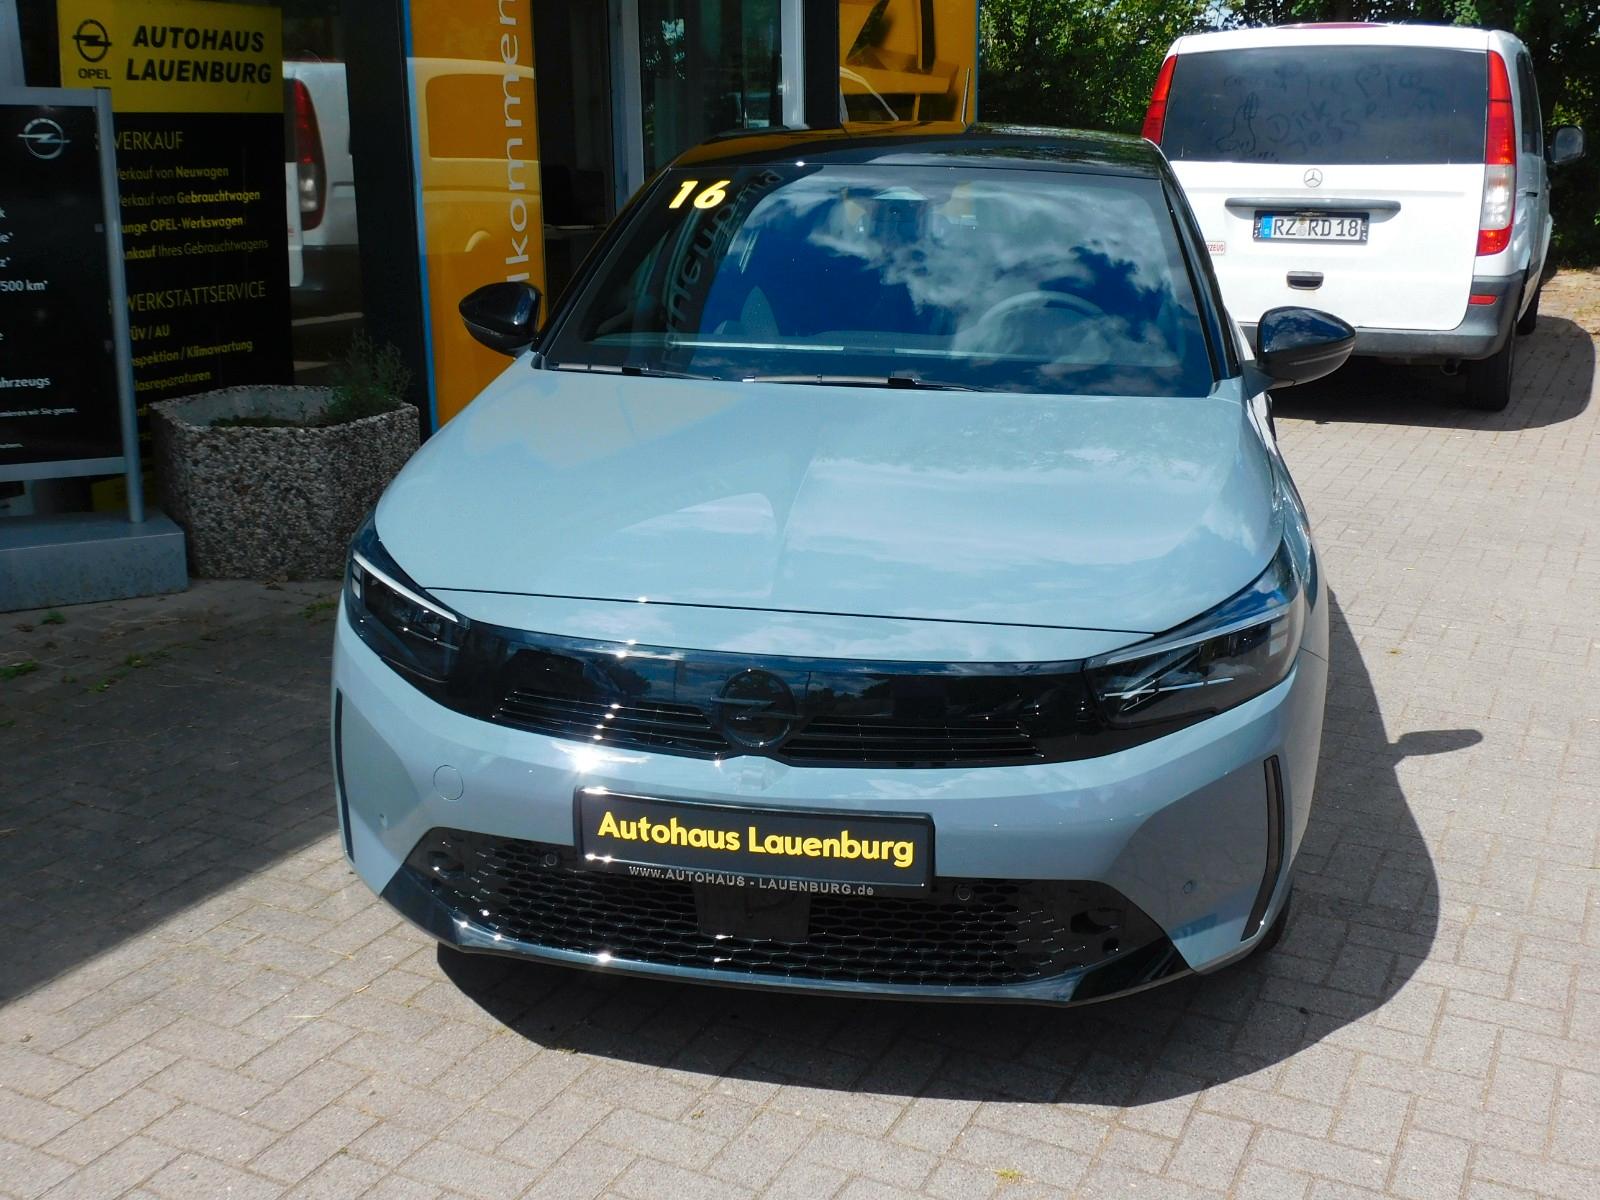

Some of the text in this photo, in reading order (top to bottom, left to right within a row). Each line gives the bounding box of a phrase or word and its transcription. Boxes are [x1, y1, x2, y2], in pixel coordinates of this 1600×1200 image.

[133, 25, 264, 52] AUTOHAUS
[78, 68, 111, 79] OPEL
[126, 59, 272, 84] LAUENBURG
[498, 0, 531, 283] lkommen
[117, 166, 155, 181] erkauf
[175, 165, 229, 180] Neuwagen
[119, 192, 156, 207] erkauf
[177, 189, 260, 205] Gebrauchtwagen
[668, 180, 730, 209] 16
[121, 215, 243, 237] unge OPEL-Werkswagen
[1273, 218, 1298, 237] RZ
[1308, 218, 1332, 237] RD
[1336, 218, 1359, 238] 18
[123, 245, 157, 260] nkauf
[130, 324, 147, 341] ÜV
[155, 323, 170, 338] AU
[131, 349, 180, 369] spektion
[135, 370, 212, 393] lasreparaturen
[597, 811, 915, 868] Autohaus Lauenburg
